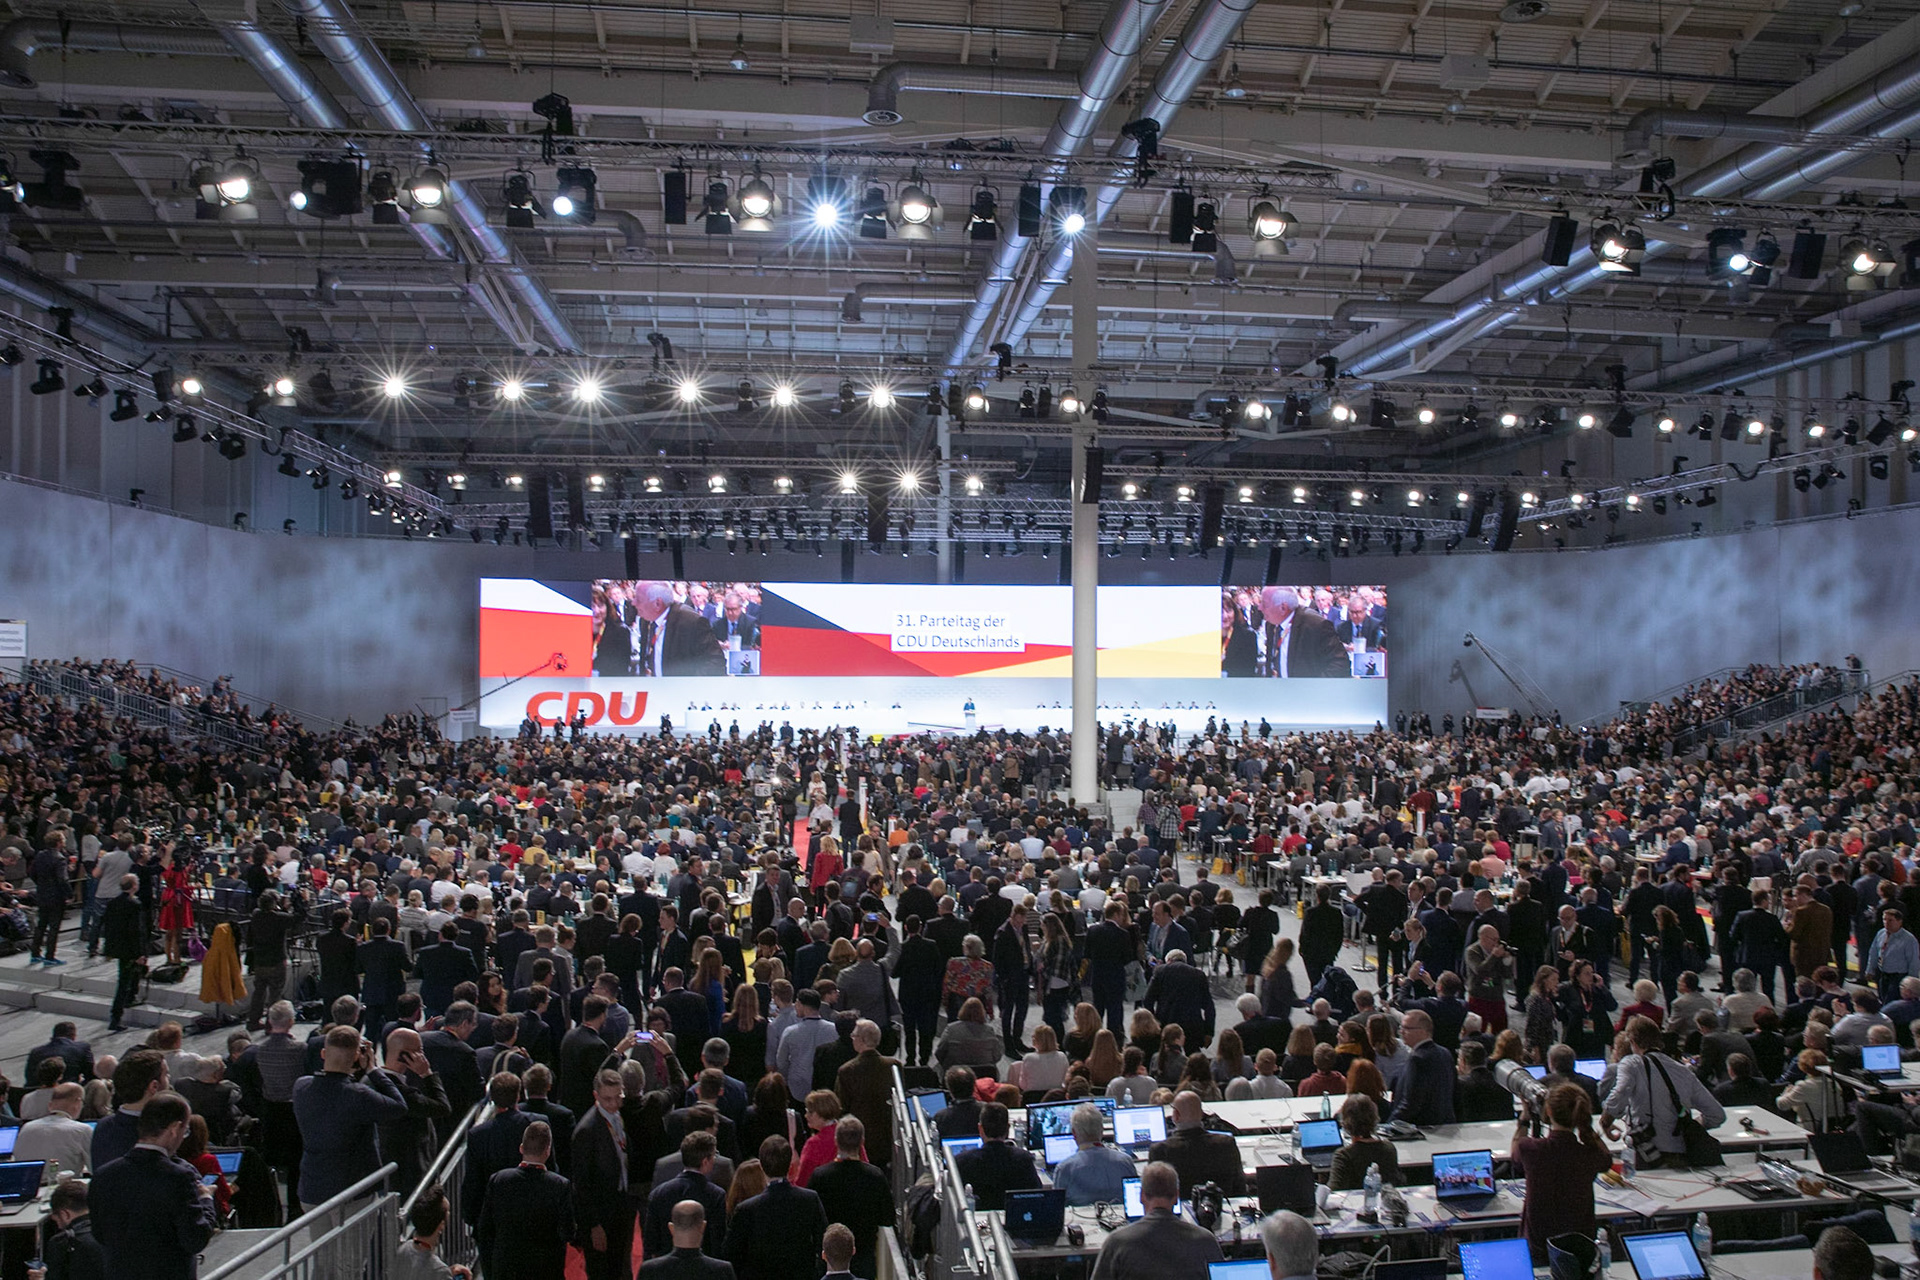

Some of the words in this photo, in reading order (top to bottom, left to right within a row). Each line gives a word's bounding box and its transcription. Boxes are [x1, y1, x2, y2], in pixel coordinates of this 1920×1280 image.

[896, 614, 916, 627] 31.
[919, 614, 981, 631] Parteitag
[983, 615, 1006, 627] der
[896, 635, 928, 648] CDU
[931, 635, 1020, 648] Deutschlands
[526, 691, 648, 726] CDU
